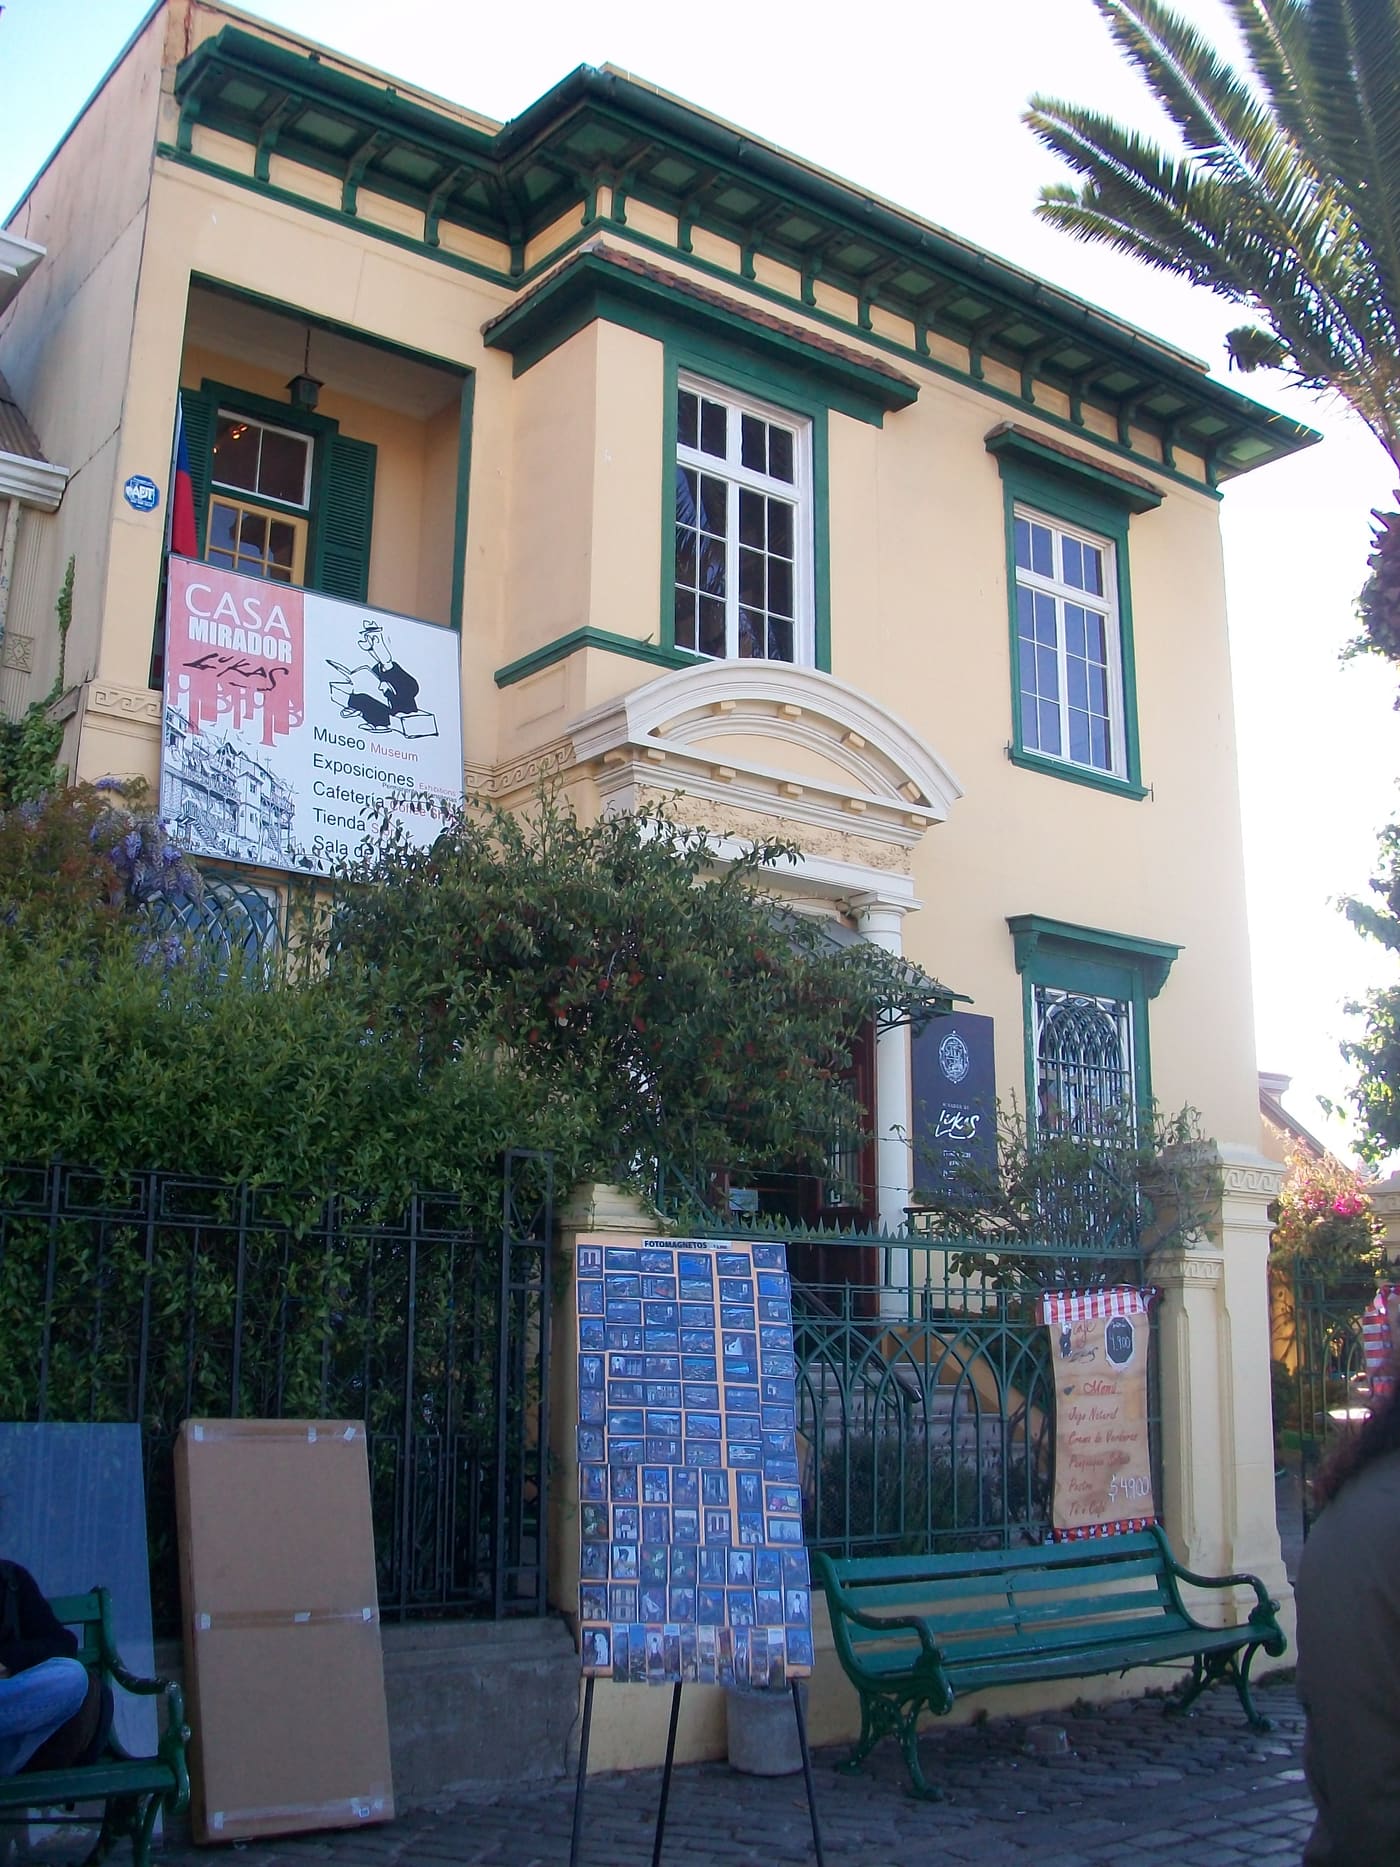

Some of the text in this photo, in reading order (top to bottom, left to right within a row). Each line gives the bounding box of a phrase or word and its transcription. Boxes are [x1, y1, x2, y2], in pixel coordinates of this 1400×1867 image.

[185, 584, 292, 639] CASA
[188, 615, 293, 665] MIRADOR
[313, 726, 418, 762] Museo Museum
[313, 752, 415, 788] Exposiciones
[313, 780, 385, 808] Cafetería
[312, 807, 366, 832] Tienda
[313, 835, 348, 857] Sala
[644, 1240, 708, 1249] FOTOMAGNETOS
